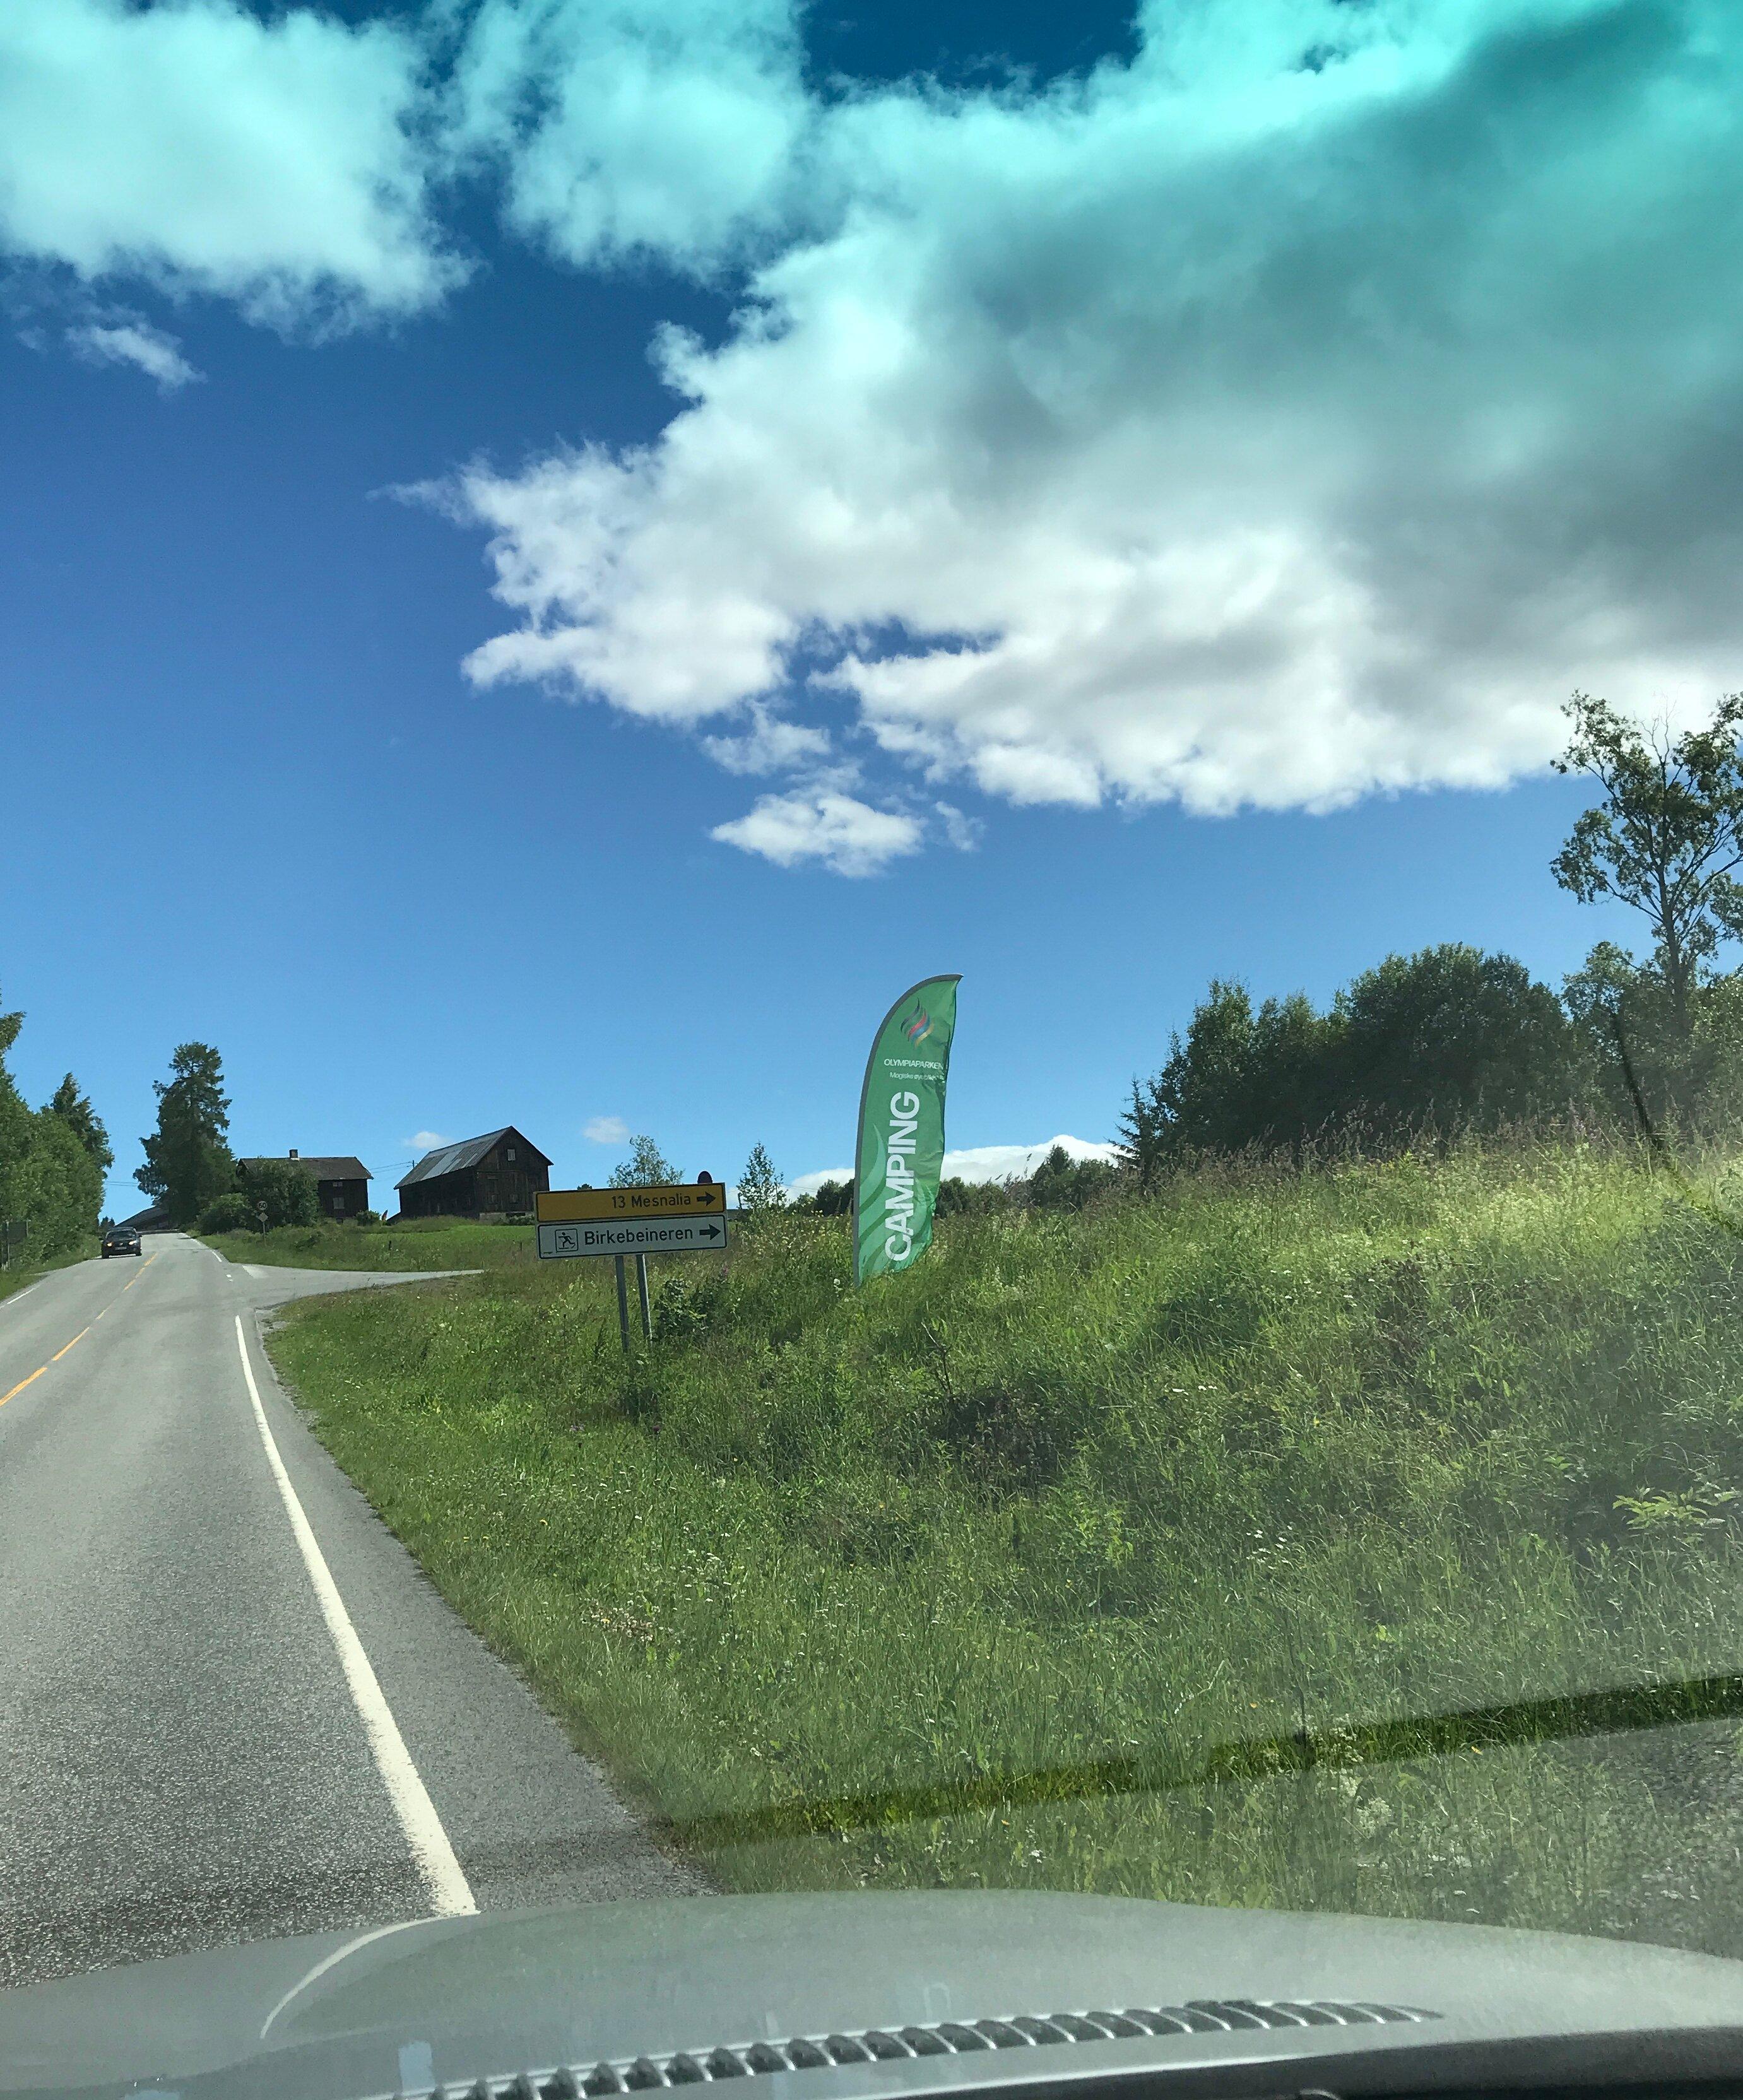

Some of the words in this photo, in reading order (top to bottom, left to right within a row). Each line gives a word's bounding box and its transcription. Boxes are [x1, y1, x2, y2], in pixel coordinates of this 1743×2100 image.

[884, 1059, 943, 1070] OLYMPIAPARKEN
[885, 1092, 919, 1261] CAMPING
[612, 1195, 626, 1208] 13
[632, 1193, 691, 1208] Mesnalia
[584, 1228, 693, 1245] Birkebeineren
